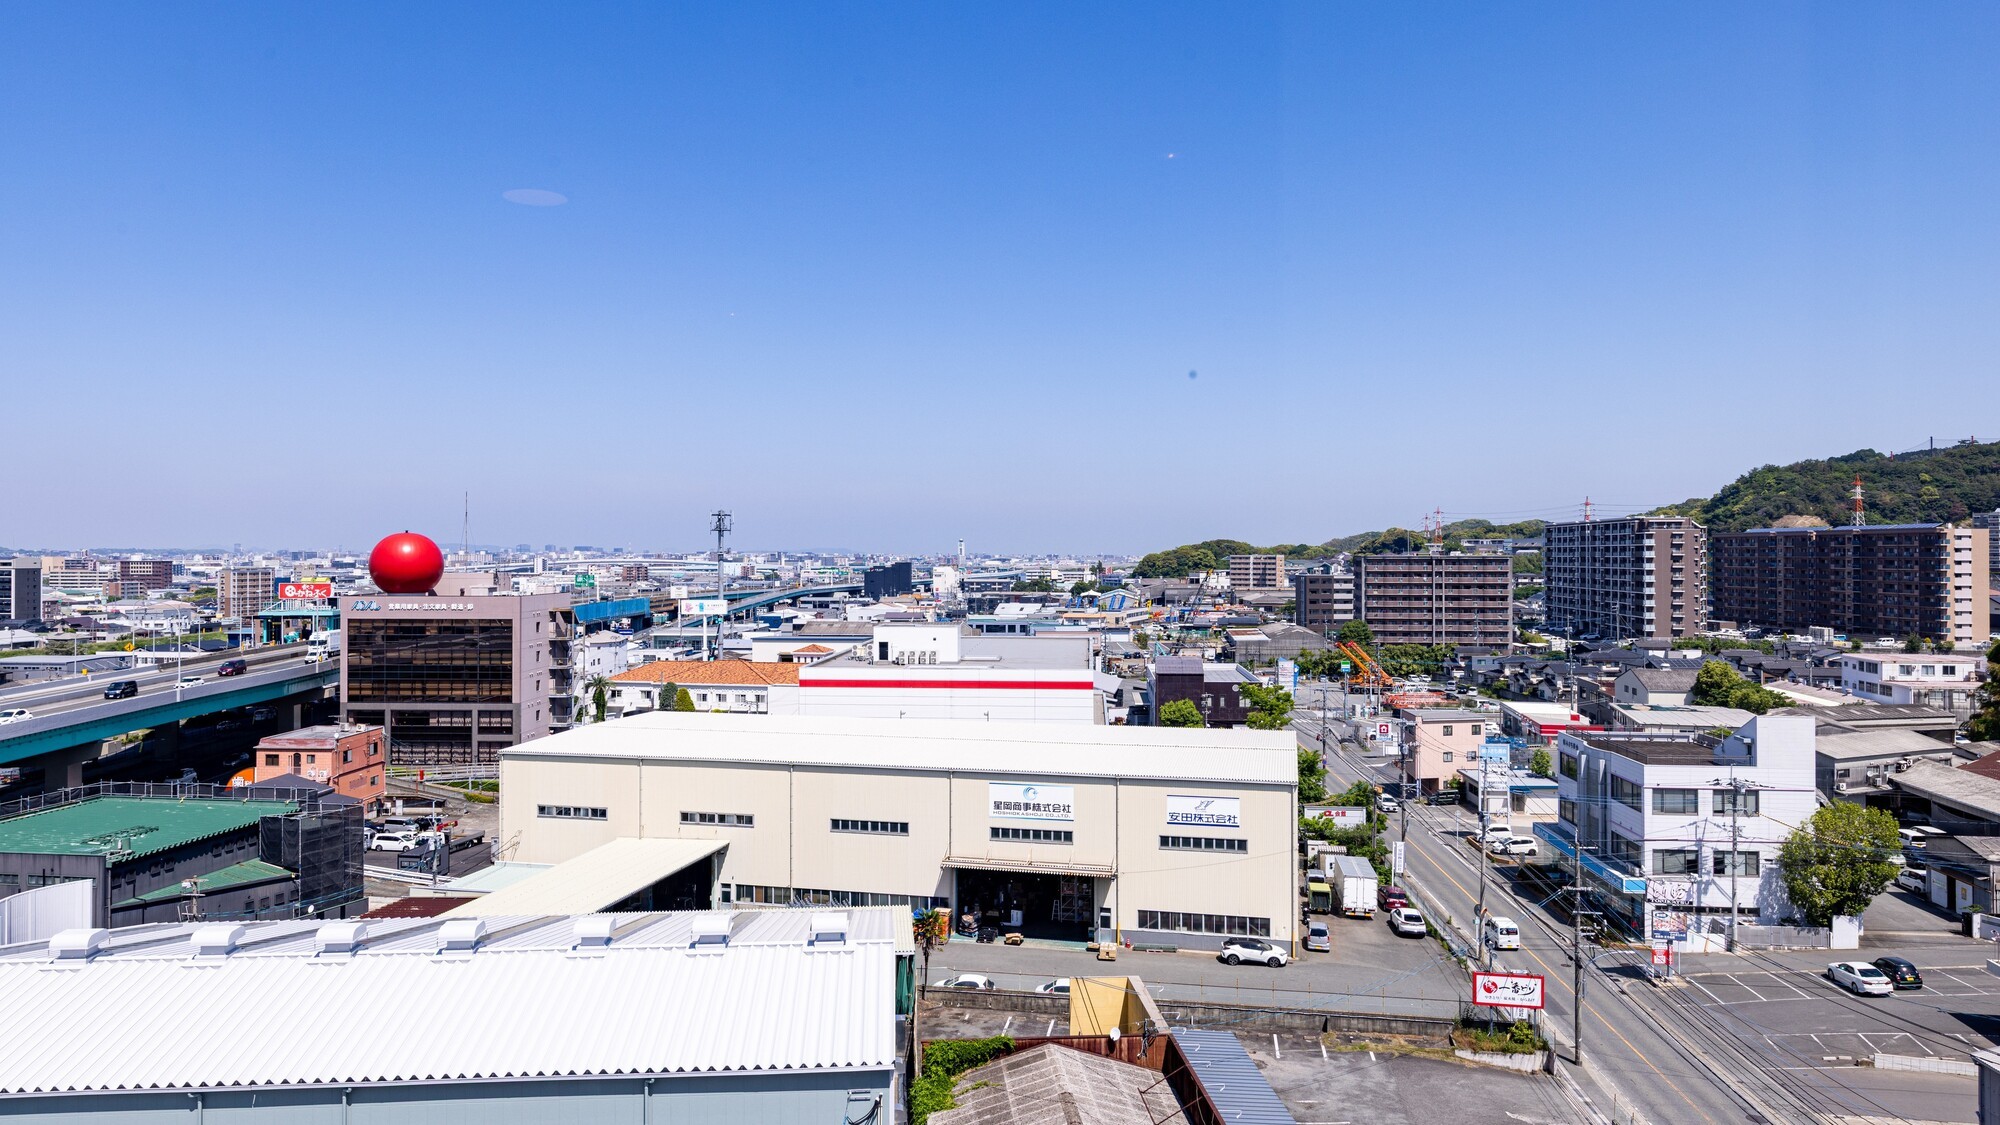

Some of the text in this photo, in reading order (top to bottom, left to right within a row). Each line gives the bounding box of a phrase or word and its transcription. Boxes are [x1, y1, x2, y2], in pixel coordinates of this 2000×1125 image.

[994, 801, 1071, 813] 星岡商事株式会社
[1169, 812, 1238, 824] 安田株式会社
